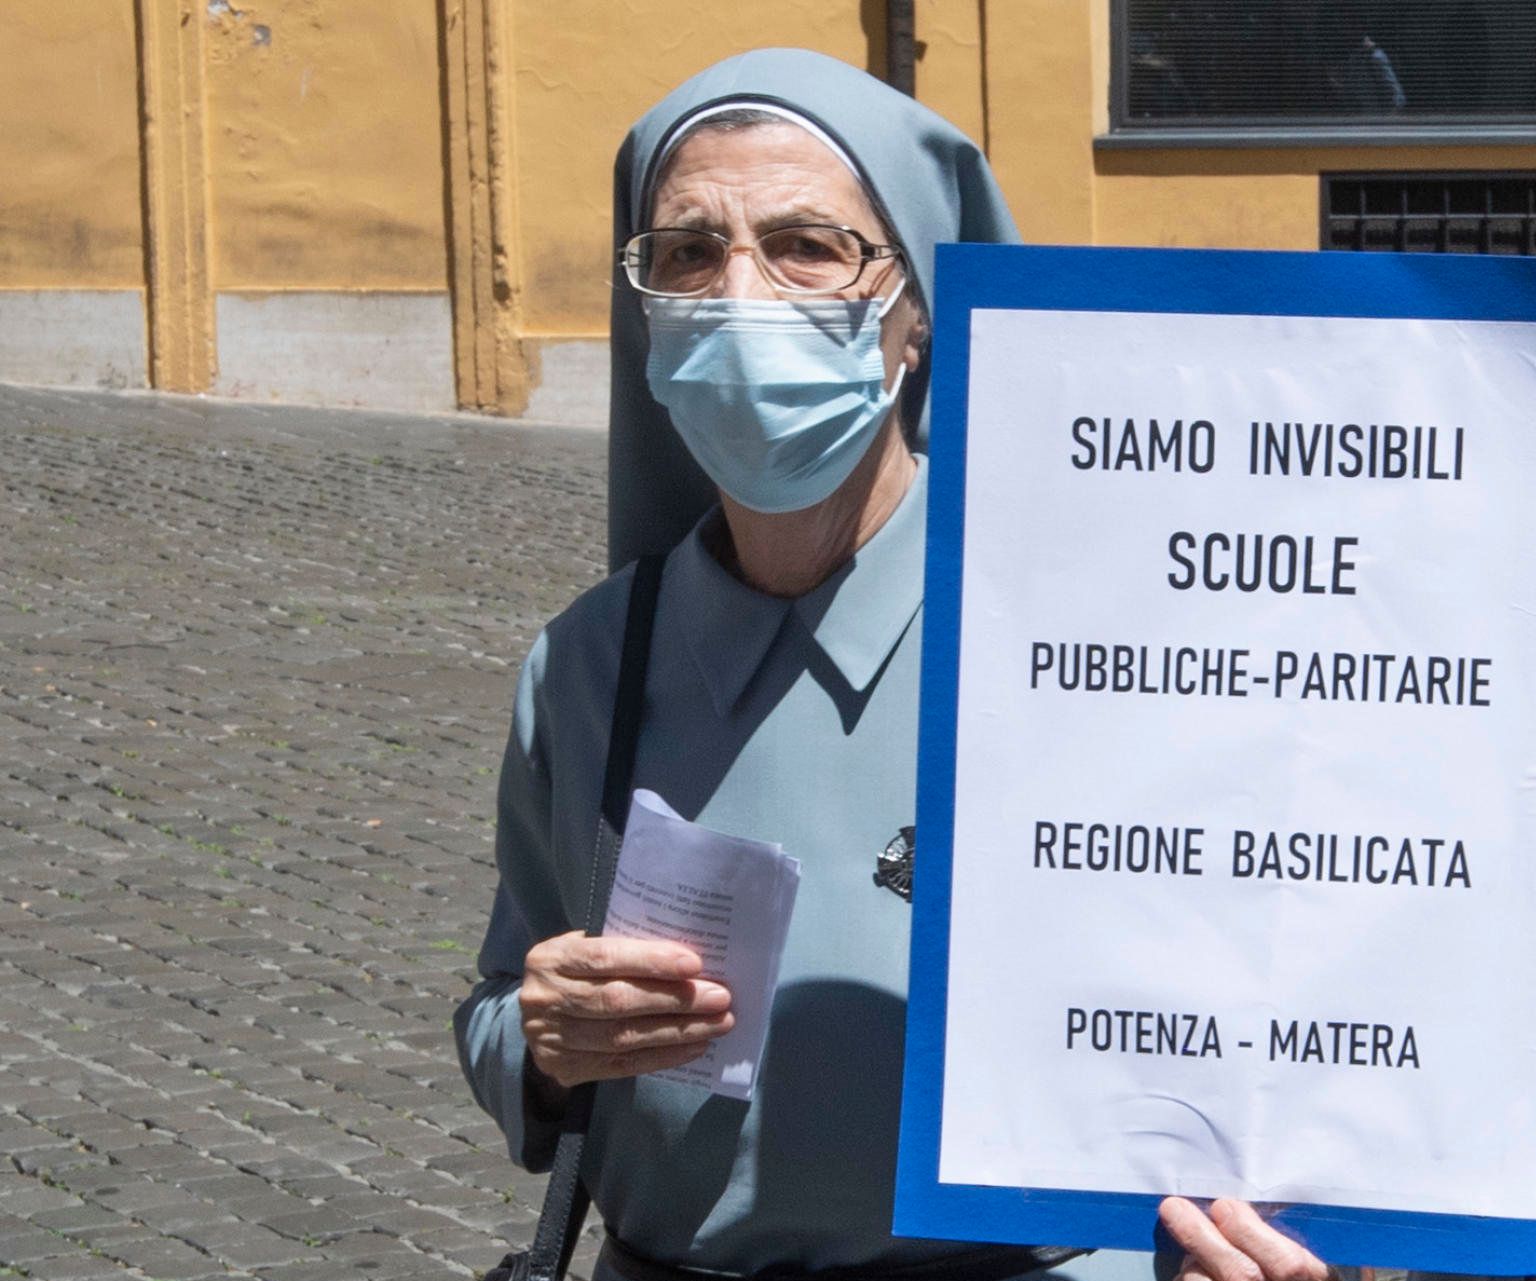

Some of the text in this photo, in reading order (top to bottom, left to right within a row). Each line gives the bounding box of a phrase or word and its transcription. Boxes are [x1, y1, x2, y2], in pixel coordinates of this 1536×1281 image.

[1070, 416, 1465, 481] SIAMO INVISIBILI
[1167, 530, 1359, 596] SCUOLE
[1030, 641, 1493, 707] PUBBLICHE-PARITARIE
[1033, 820, 1472, 889] REGIONE BASILICATA
[1066, 1007, 1421, 1070] POTENZA - MATERA
